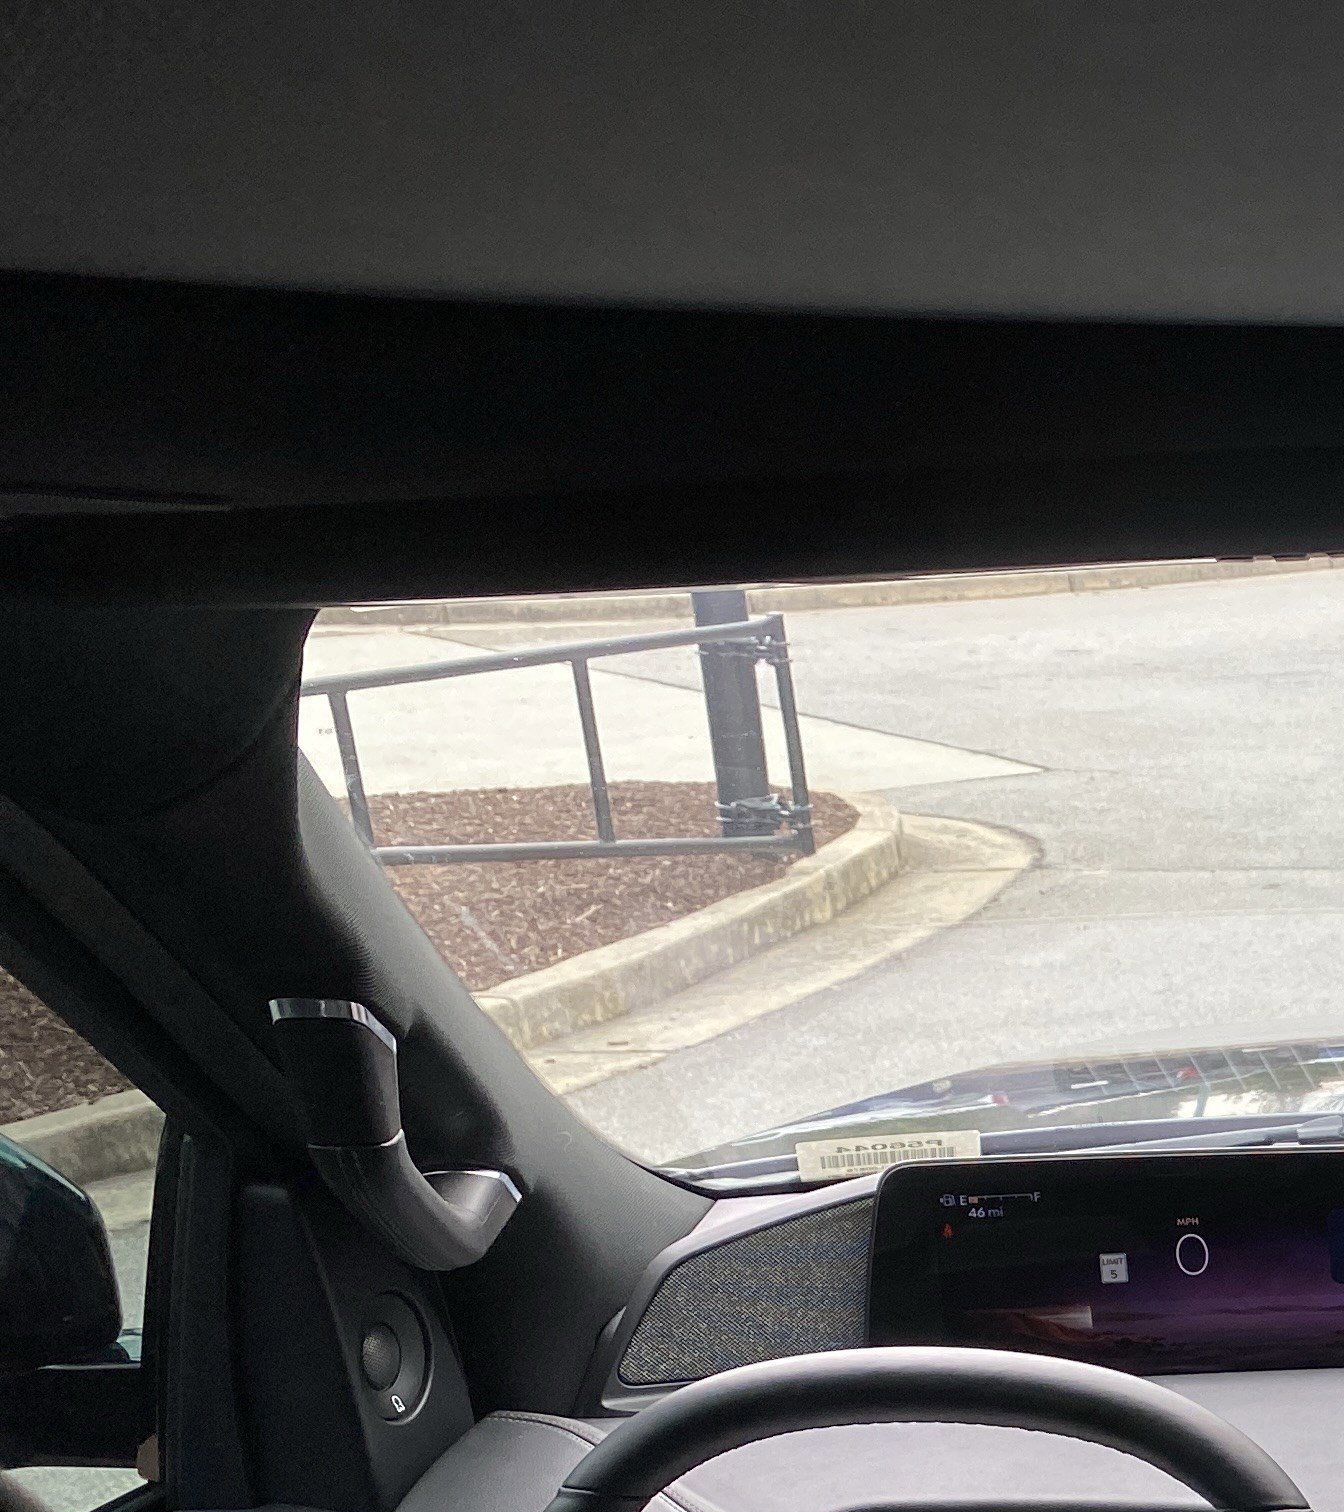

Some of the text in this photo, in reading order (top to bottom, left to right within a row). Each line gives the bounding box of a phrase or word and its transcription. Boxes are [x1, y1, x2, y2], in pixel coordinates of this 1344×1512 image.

[960, 1195, 968, 1206] E
[1033, 1191, 1041, 1202] F
[968, 1206, 1004, 1218] 46 mi
[1176, 1217, 1200, 1226] MPH
[1175, 1233, 1209, 1276] 0
[1110, 1269, 1118, 1279] 5
